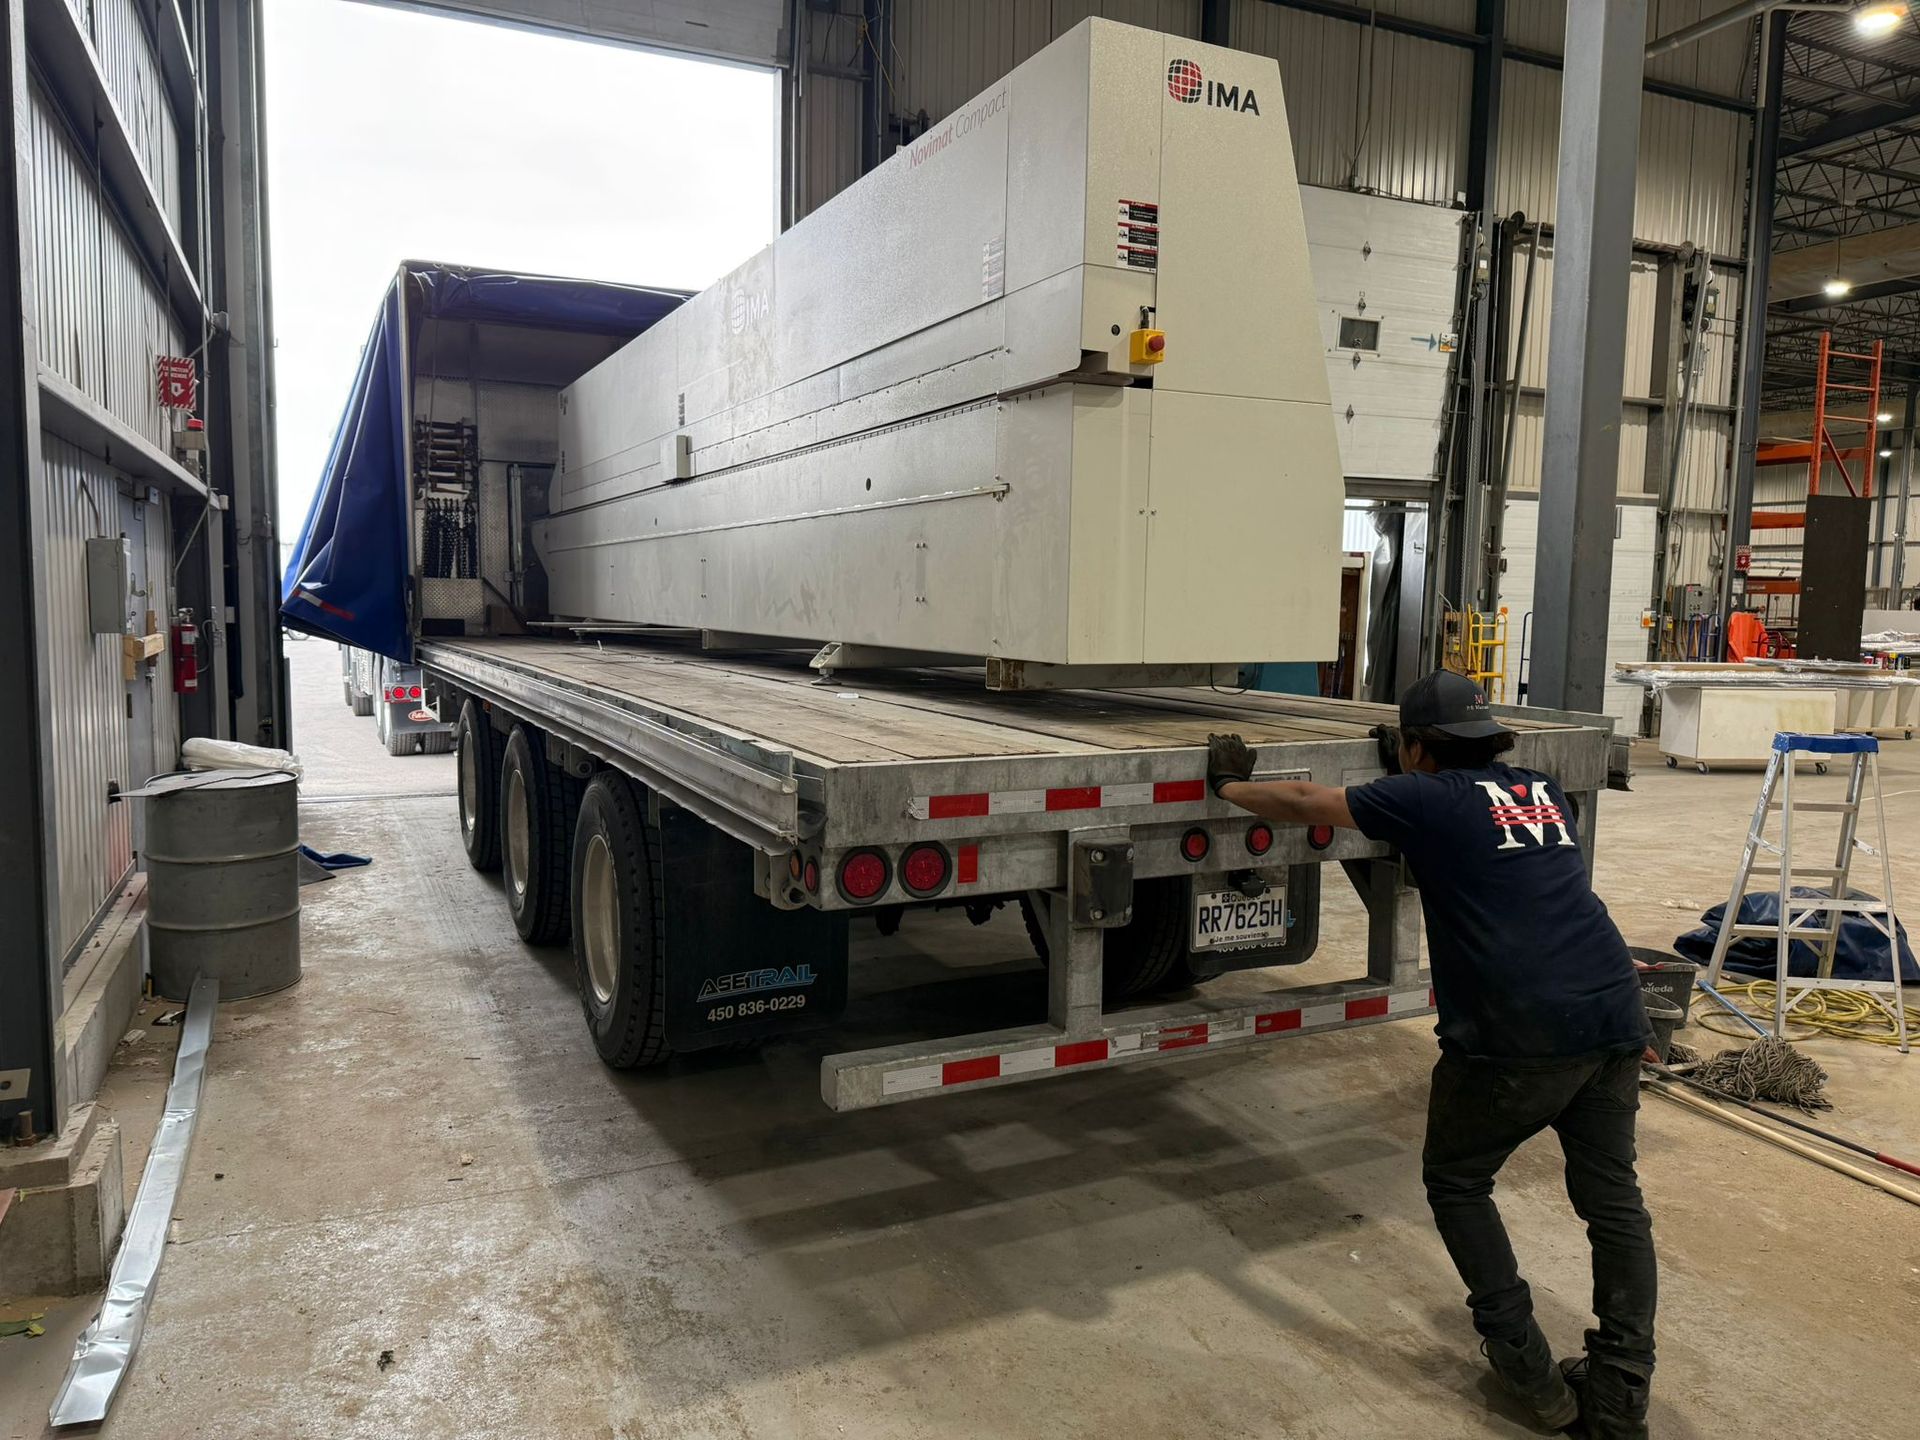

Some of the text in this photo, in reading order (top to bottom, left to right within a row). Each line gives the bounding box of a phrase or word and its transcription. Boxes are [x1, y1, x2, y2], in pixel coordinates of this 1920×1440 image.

[1207, 80, 1260, 116] IMA
[909, 87, 1007, 169] Novimat Compact
[746, 289, 769, 326] IMA
[1198, 899, 1282, 934] RR7625H
[696, 963, 818, 1002] ASETRAIL
[707, 994, 806, 1022] 450 836-0229
